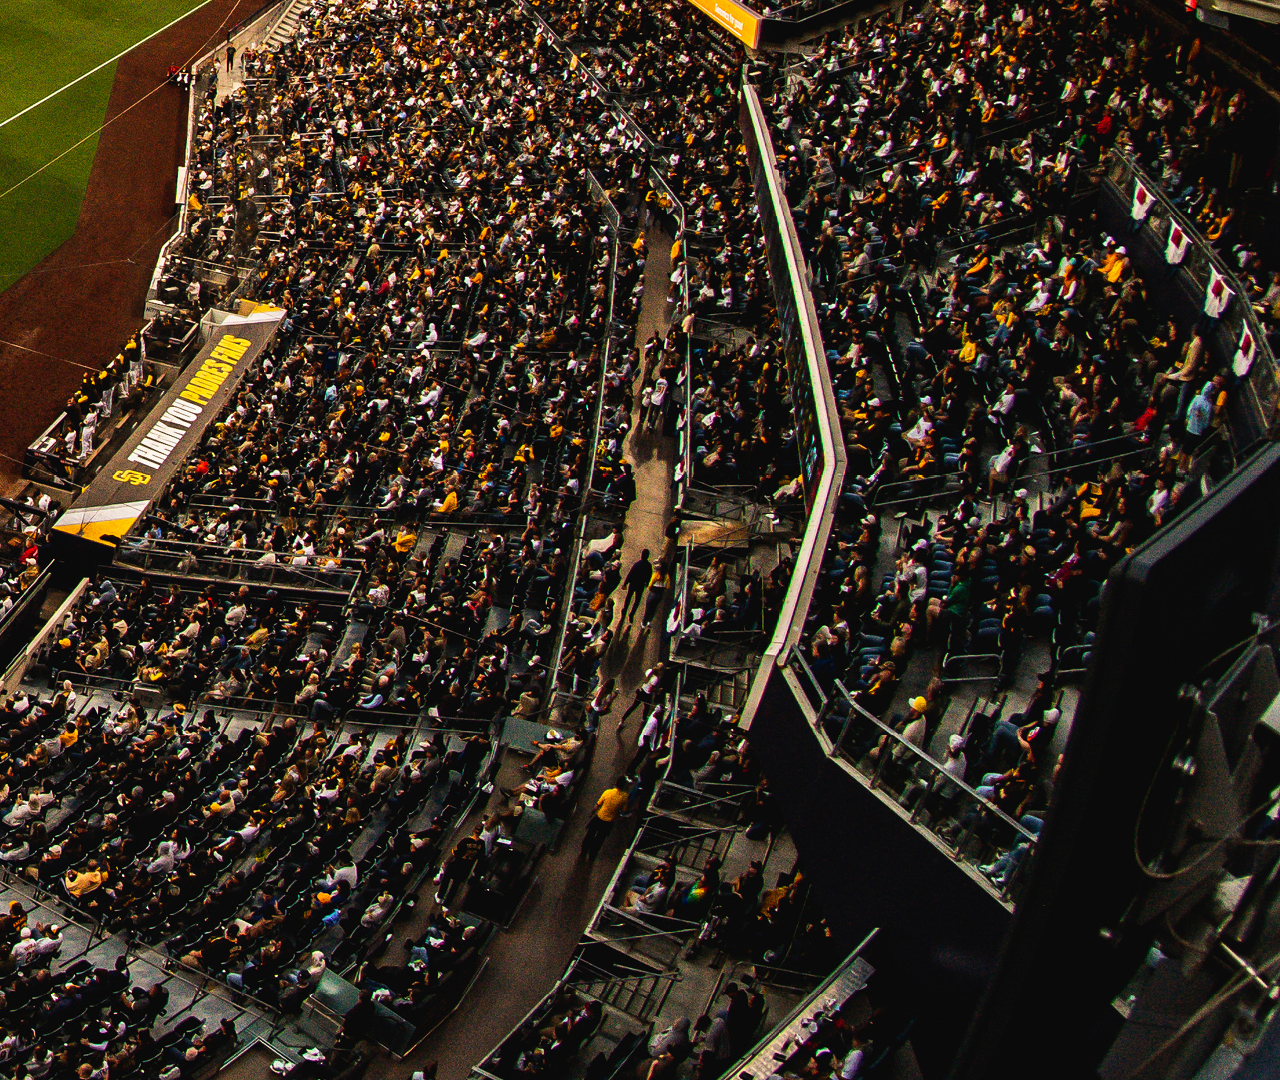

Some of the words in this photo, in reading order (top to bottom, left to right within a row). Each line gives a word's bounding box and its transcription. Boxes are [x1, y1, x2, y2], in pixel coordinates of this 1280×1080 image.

[210, 334, 252, 366] FANS
[180, 358, 233, 406] PADRES
[160, 398, 203, 428] YOU
[128, 420, 186, 470] THANK
